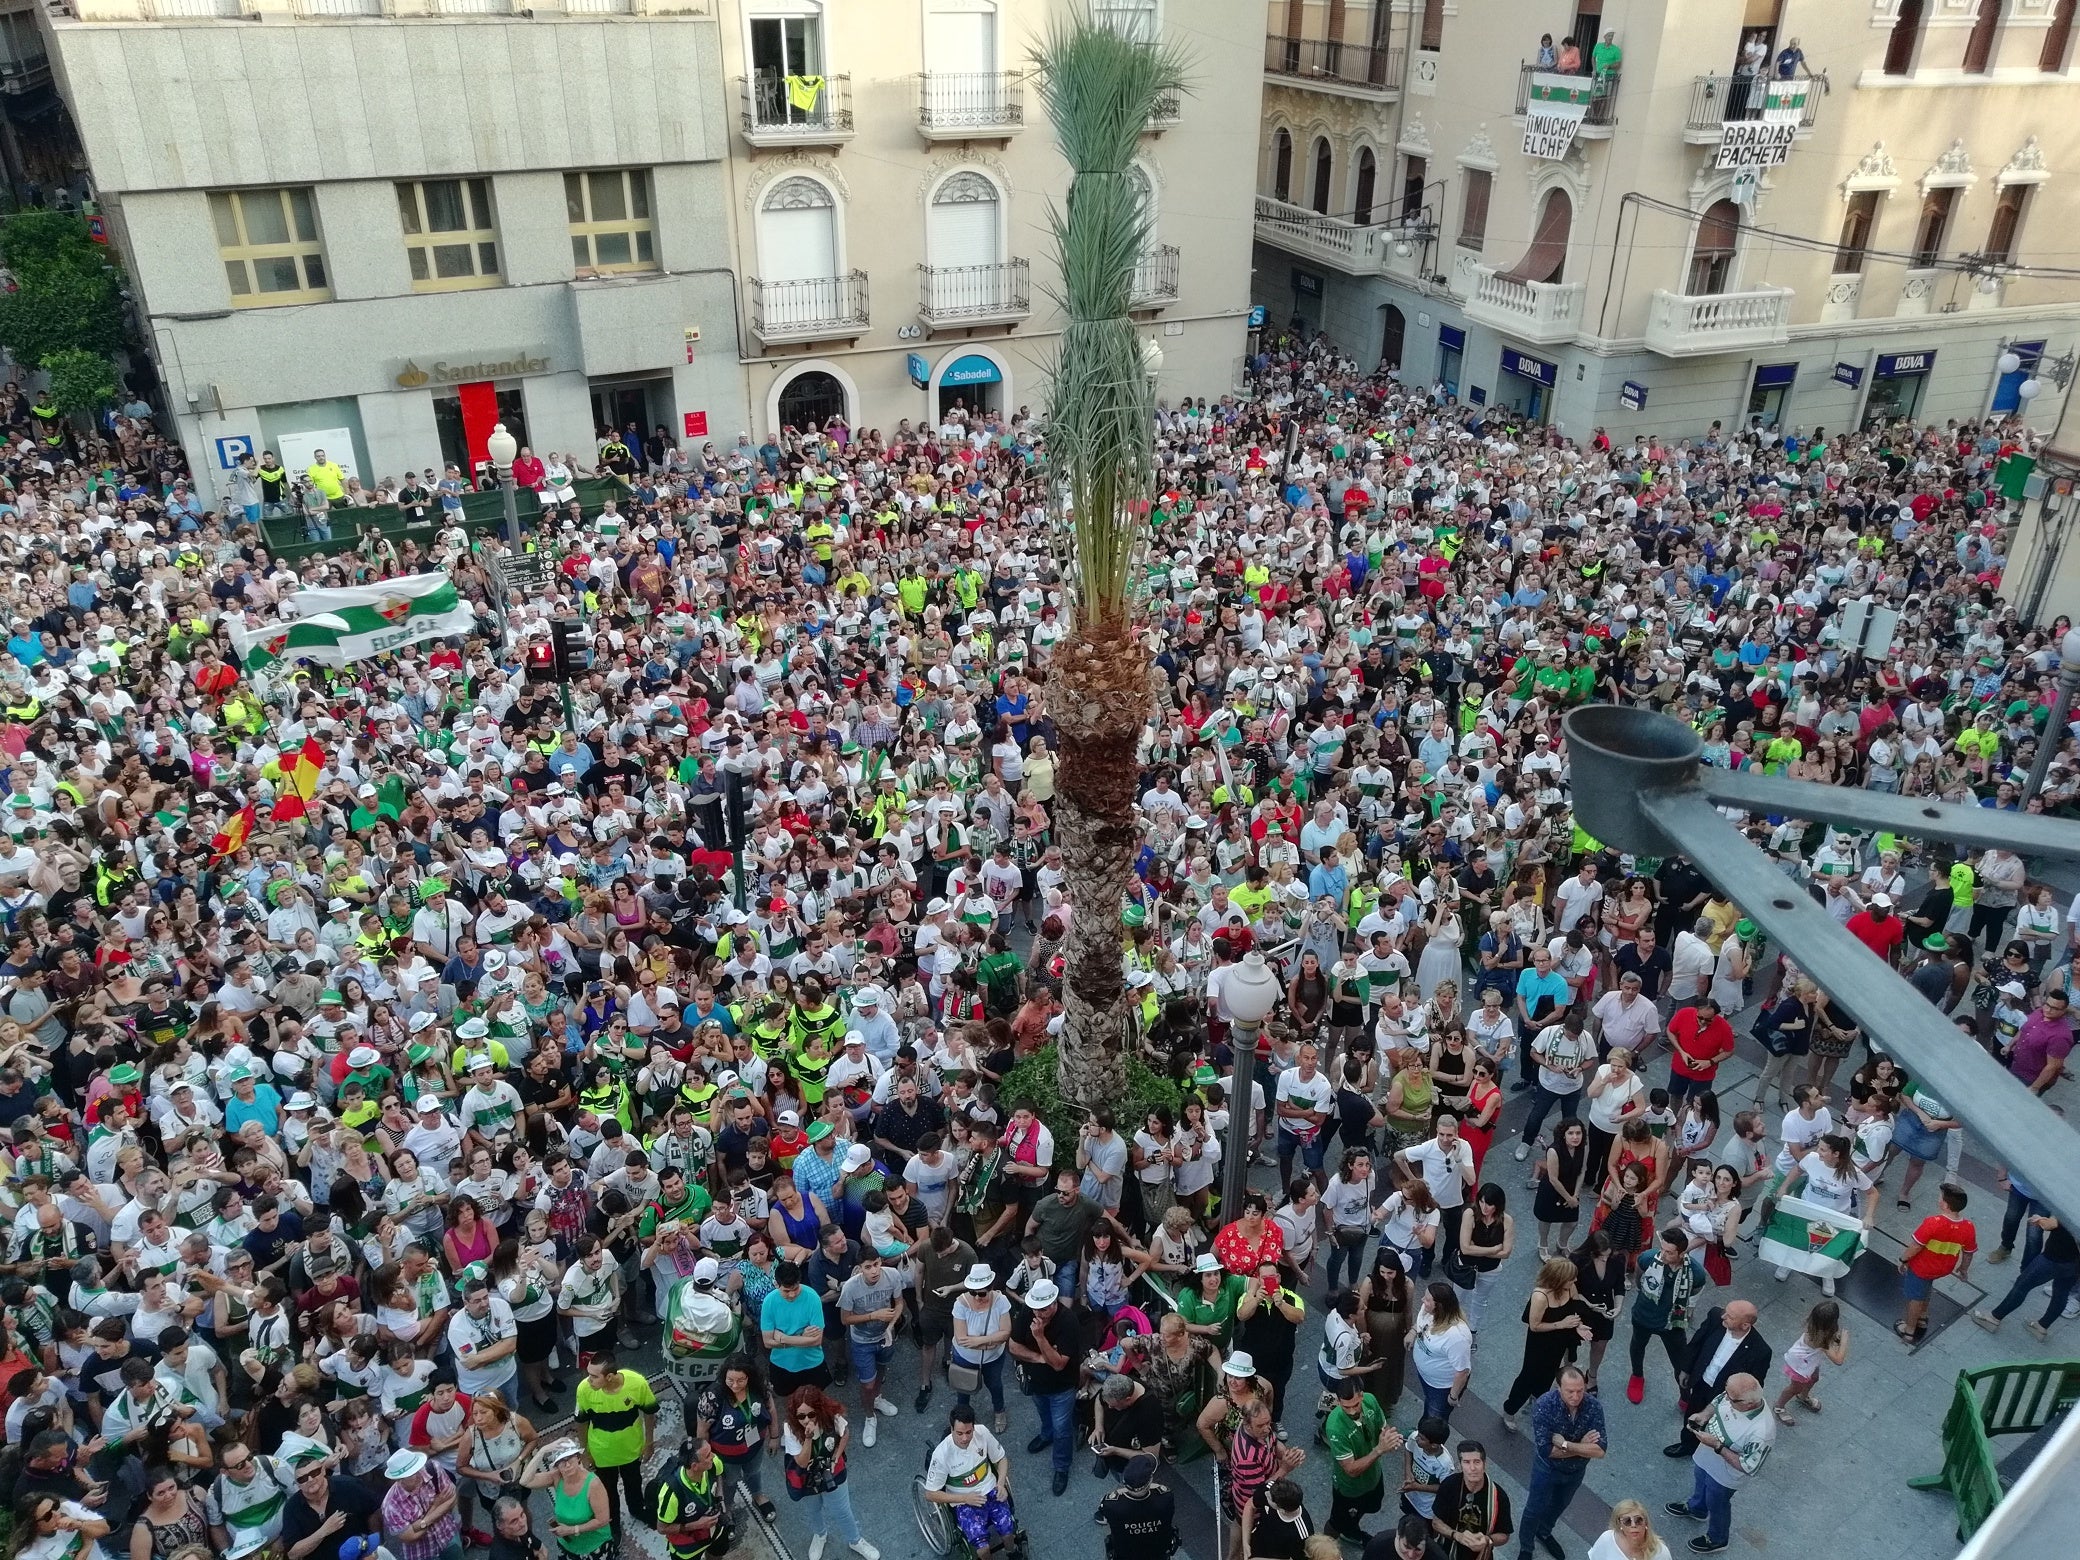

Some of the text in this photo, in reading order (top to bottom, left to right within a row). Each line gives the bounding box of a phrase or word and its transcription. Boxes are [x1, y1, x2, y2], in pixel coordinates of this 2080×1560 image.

[1723, 125, 1796, 146] GRACIAS
[1717, 145, 1788, 166] PACHETA
[1742, 174, 1751, 185] 7
[433, 351, 551, 381] Santander
[1518, 357, 1541, 378] BBVA
[1895, 355, 1925, 370] BBVA
[954, 369, 992, 380] Sabadell
[1837, 367, 1853, 379] BBVA
[1624, 385, 1639, 399] BBVA
[222, 439, 247, 466] P
[192, 1203, 213, 1219] GIOS
[964, 1475, 976, 1485] TM
[1129, 1526, 1158, 1535] LOCAL
